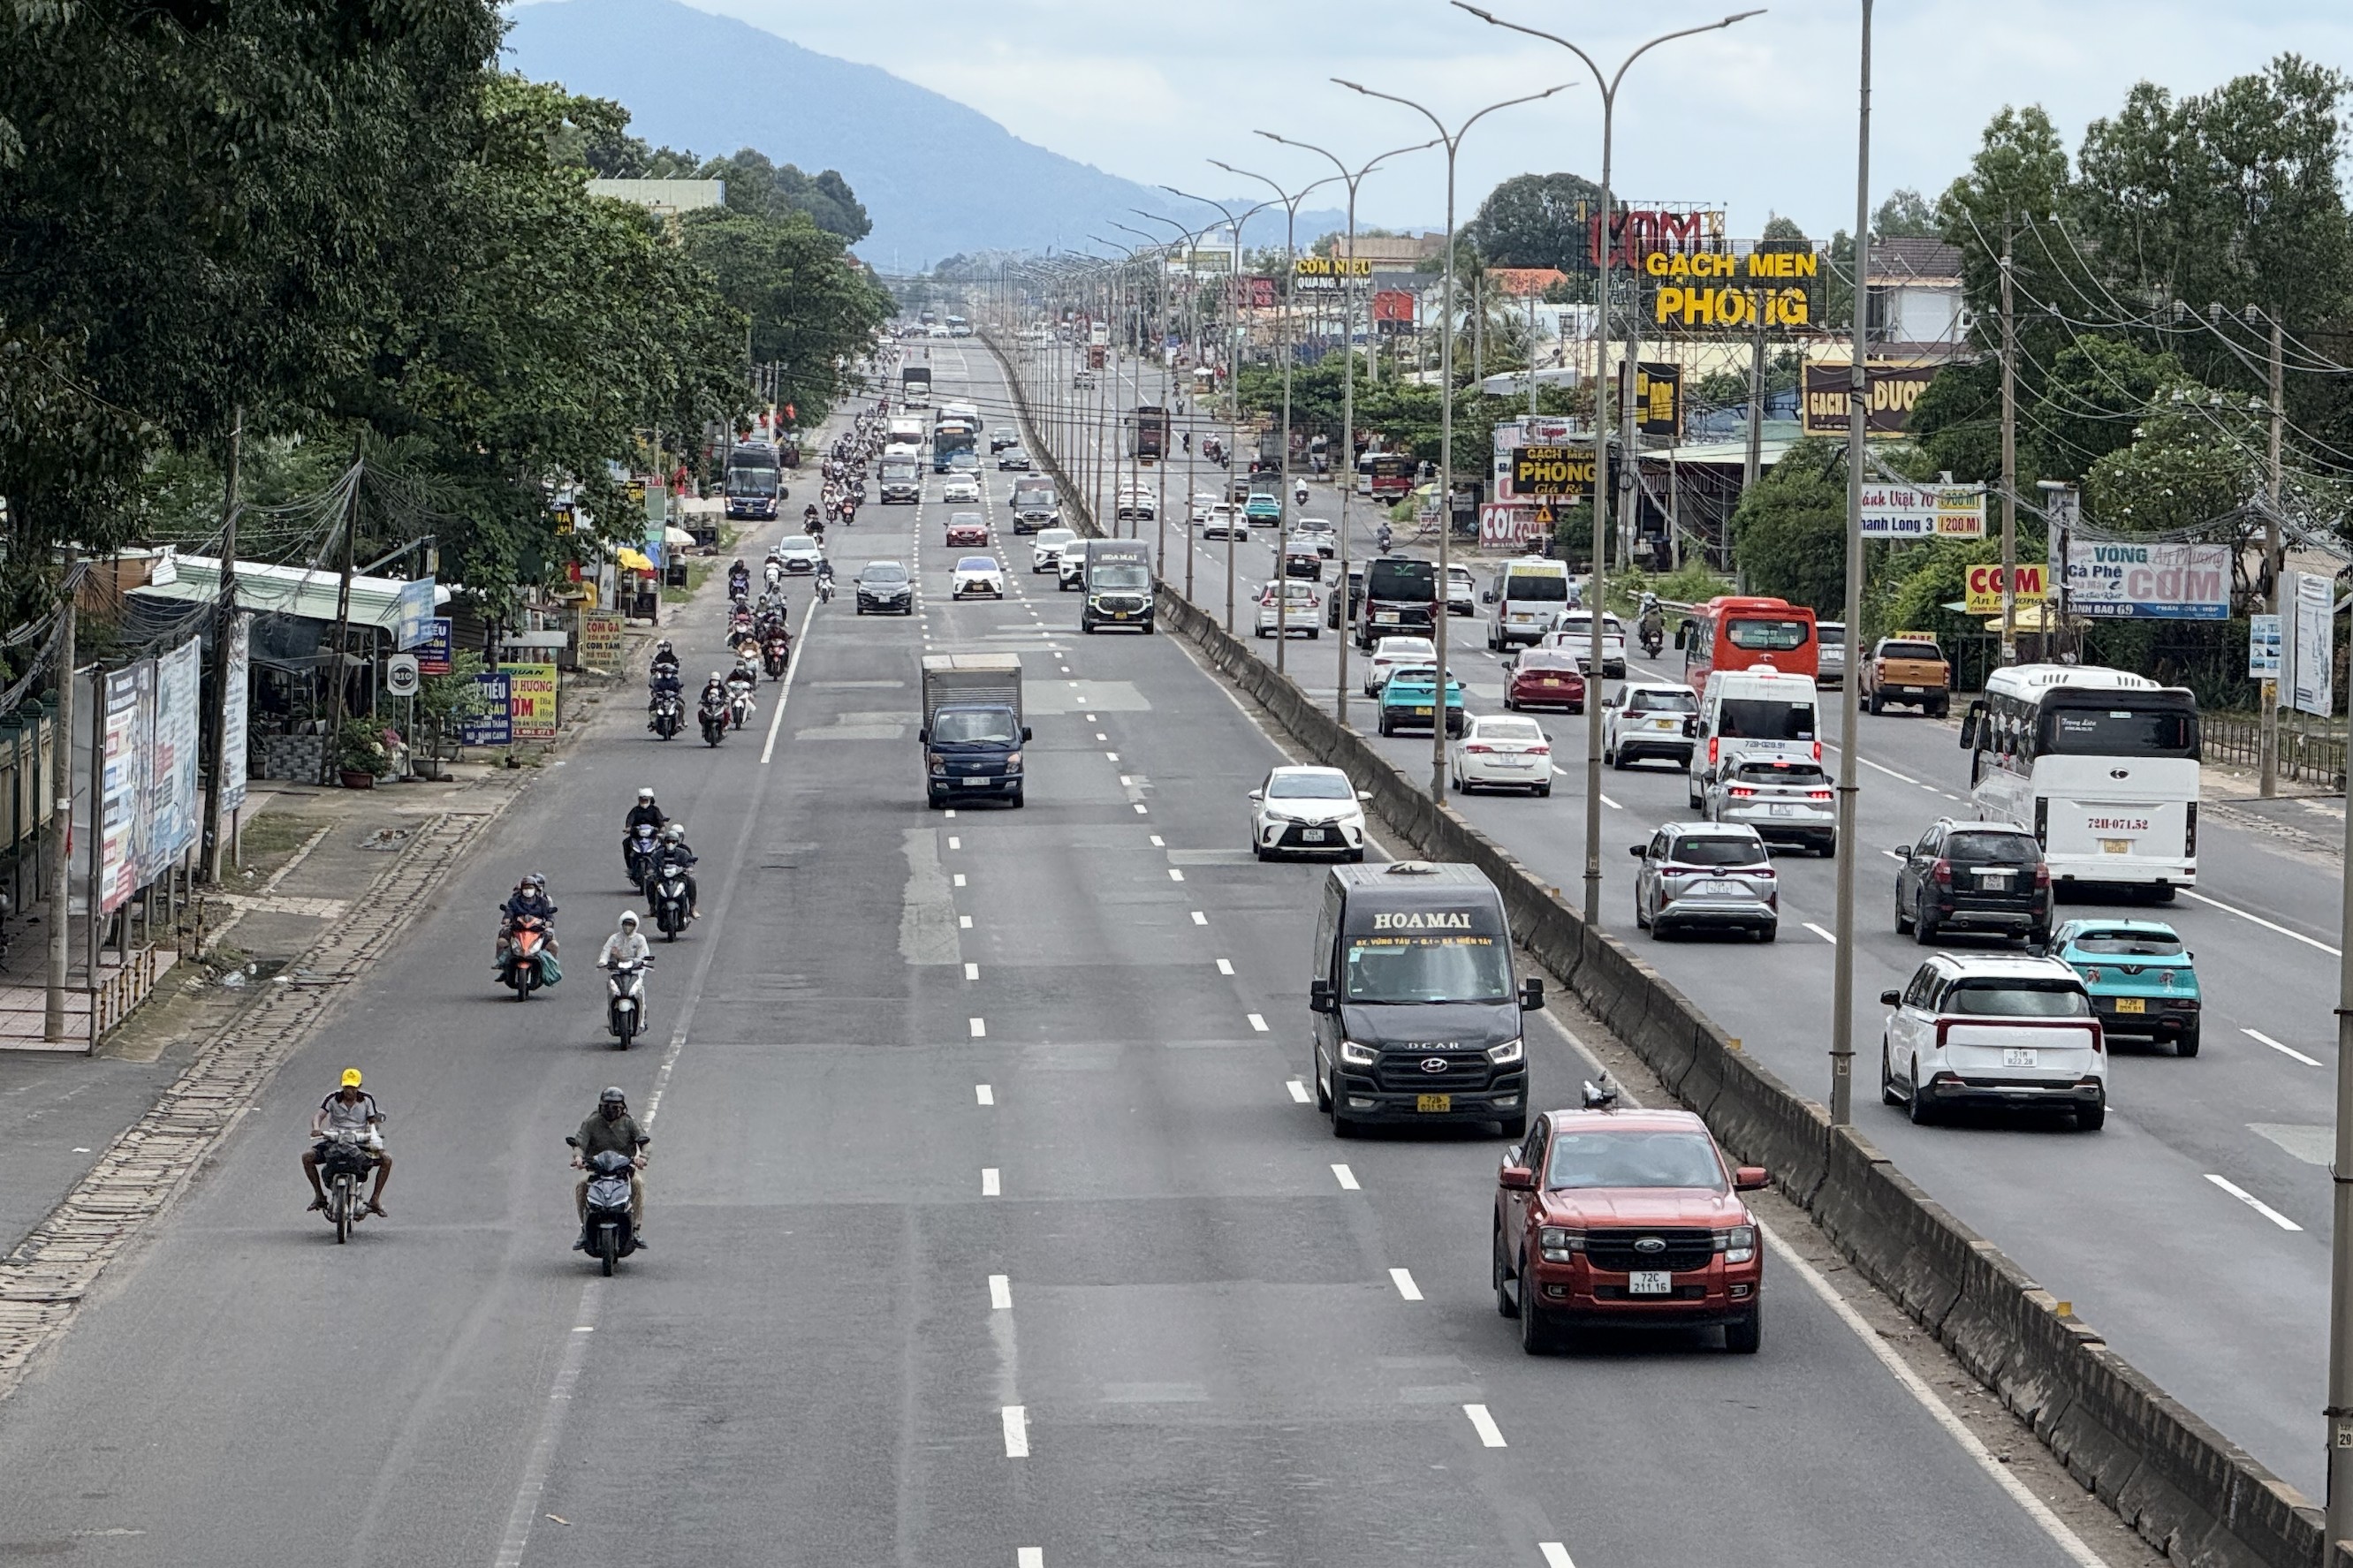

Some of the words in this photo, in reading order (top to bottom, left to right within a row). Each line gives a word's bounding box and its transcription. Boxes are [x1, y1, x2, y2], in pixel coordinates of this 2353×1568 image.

[1646, 252, 1734, 284] GẠCH
[1750, 254, 1818, 277] MEN
[1519, 461, 1597, 482] PHONG
[1890, 490, 1916, 511] Việt
[1893, 517, 1921, 533] Long
[1926, 518, 1934, 531] 3
[2092, 565, 2122, 578] Phê
[2128, 567, 2220, 602] CƠM
[2117, 604, 2134, 616] 69
[512, 695, 534, 717] ƠM
[1374, 913, 1424, 929] HOA
[1426, 913, 1471, 929] MAI
[1642, 1273, 1658, 1282] 72C
